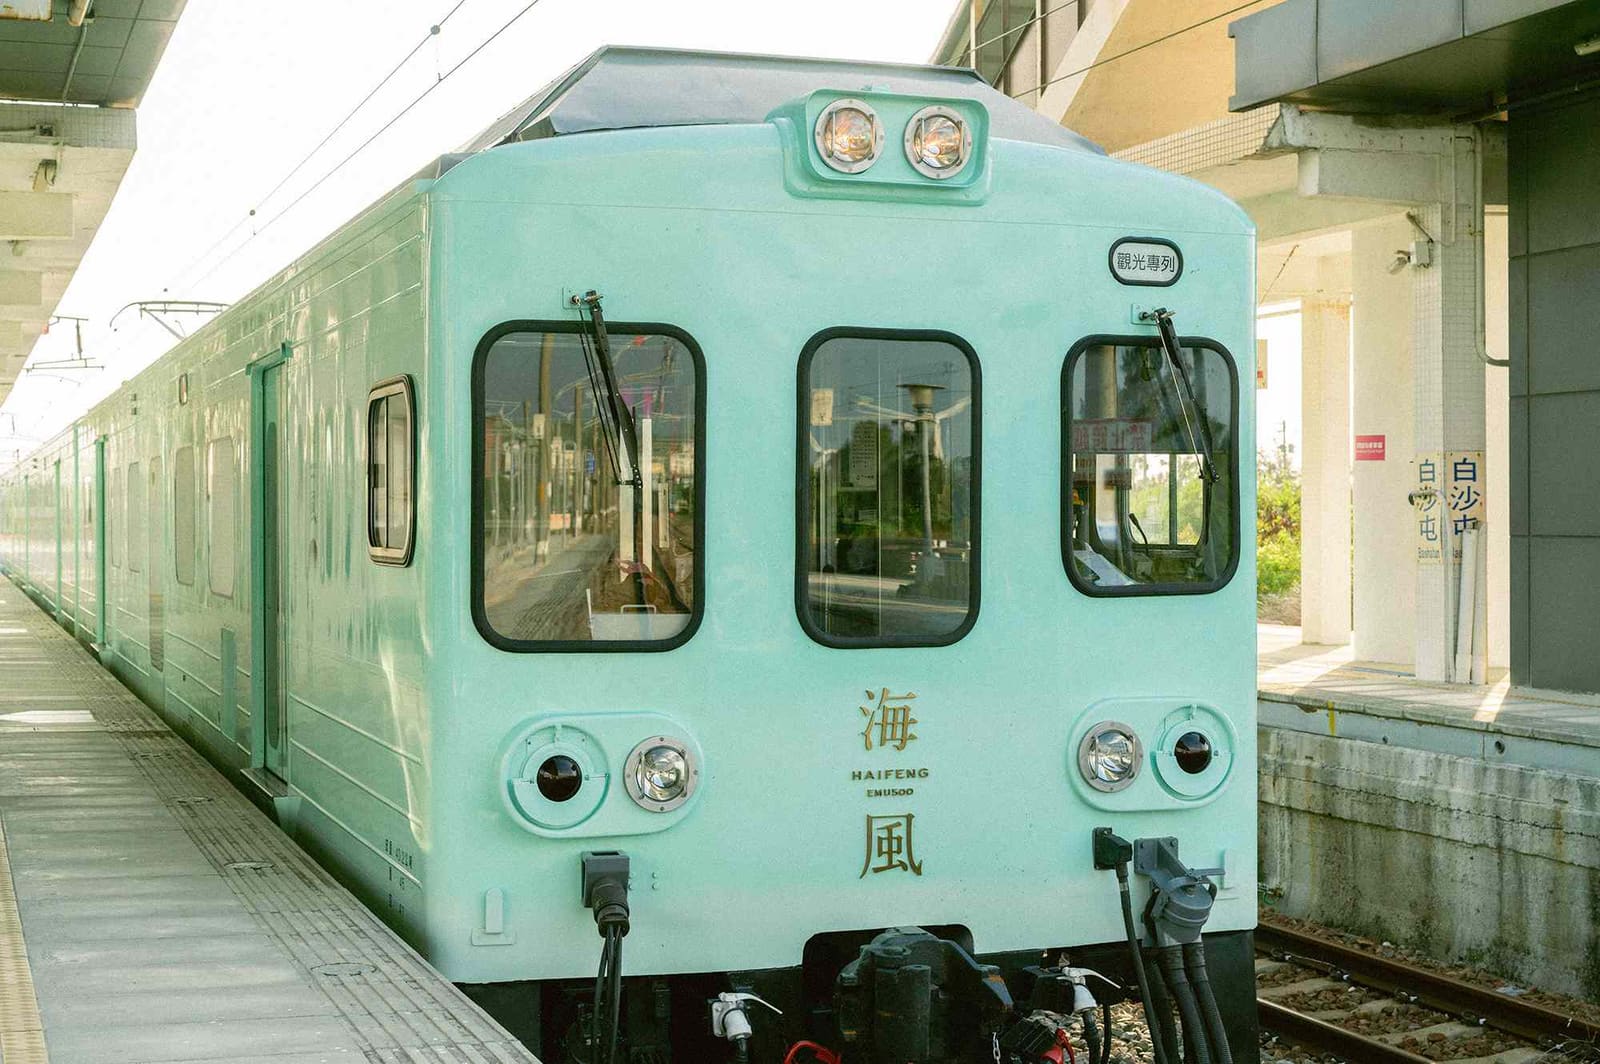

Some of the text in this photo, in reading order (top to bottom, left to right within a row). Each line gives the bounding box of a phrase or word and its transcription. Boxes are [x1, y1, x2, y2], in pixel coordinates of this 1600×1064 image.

[1117, 252, 1175, 273] 觀光專列
[858, 687, 919, 752] 海
[851, 768, 930, 781] HAIFENG
[866, 788, 914, 798] EMU500
[859, 812, 923, 880] 風
